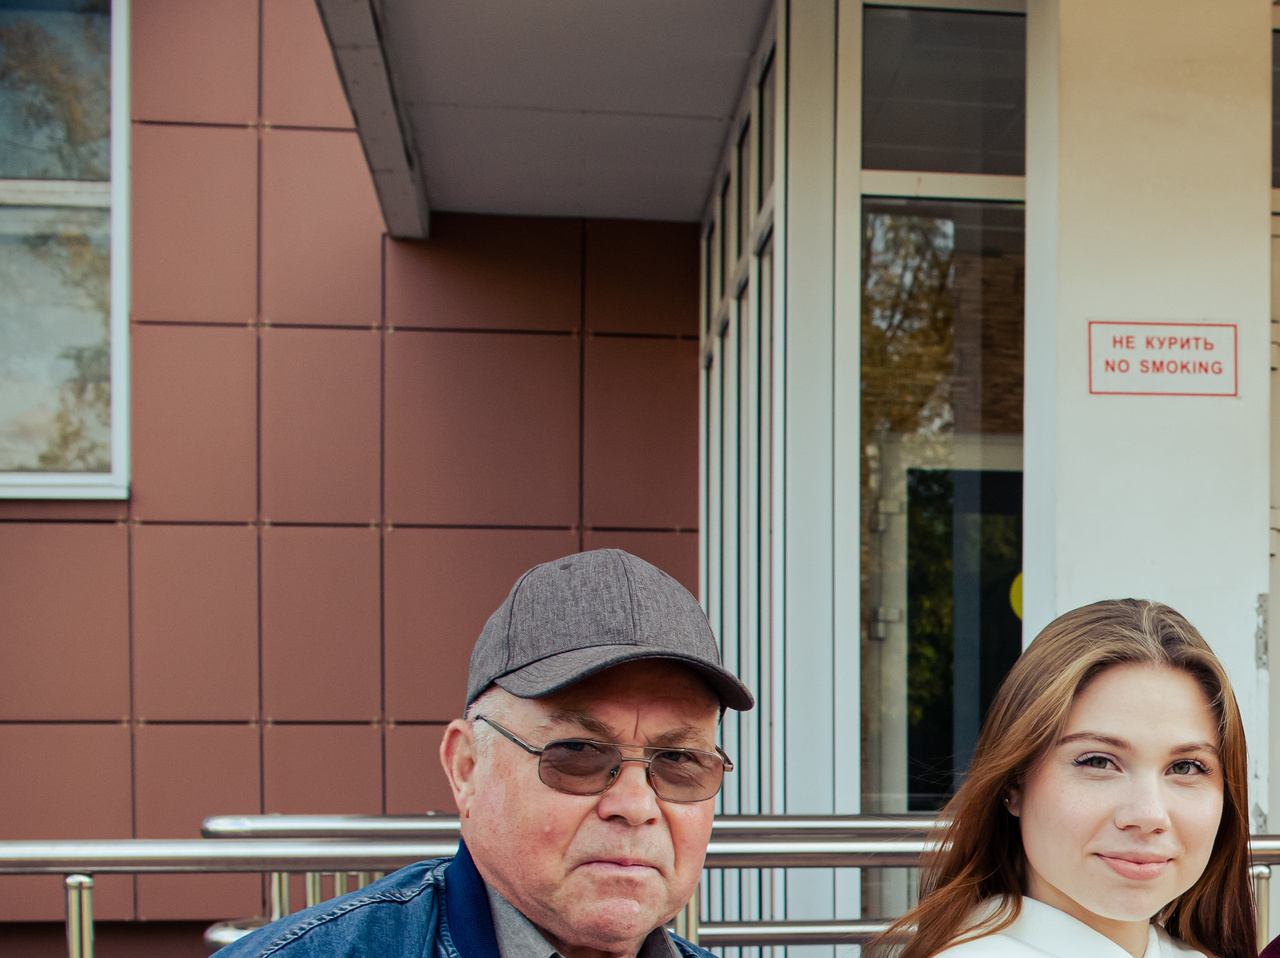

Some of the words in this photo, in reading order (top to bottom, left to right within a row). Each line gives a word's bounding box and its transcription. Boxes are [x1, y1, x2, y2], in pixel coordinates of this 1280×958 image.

[1112, 335, 1136, 350] НЕ
[1145, 336, 1215, 351] КУРИТЬ
[1104, 359, 1130, 373] NO
[1139, 360, 1224, 375] SMOKING
